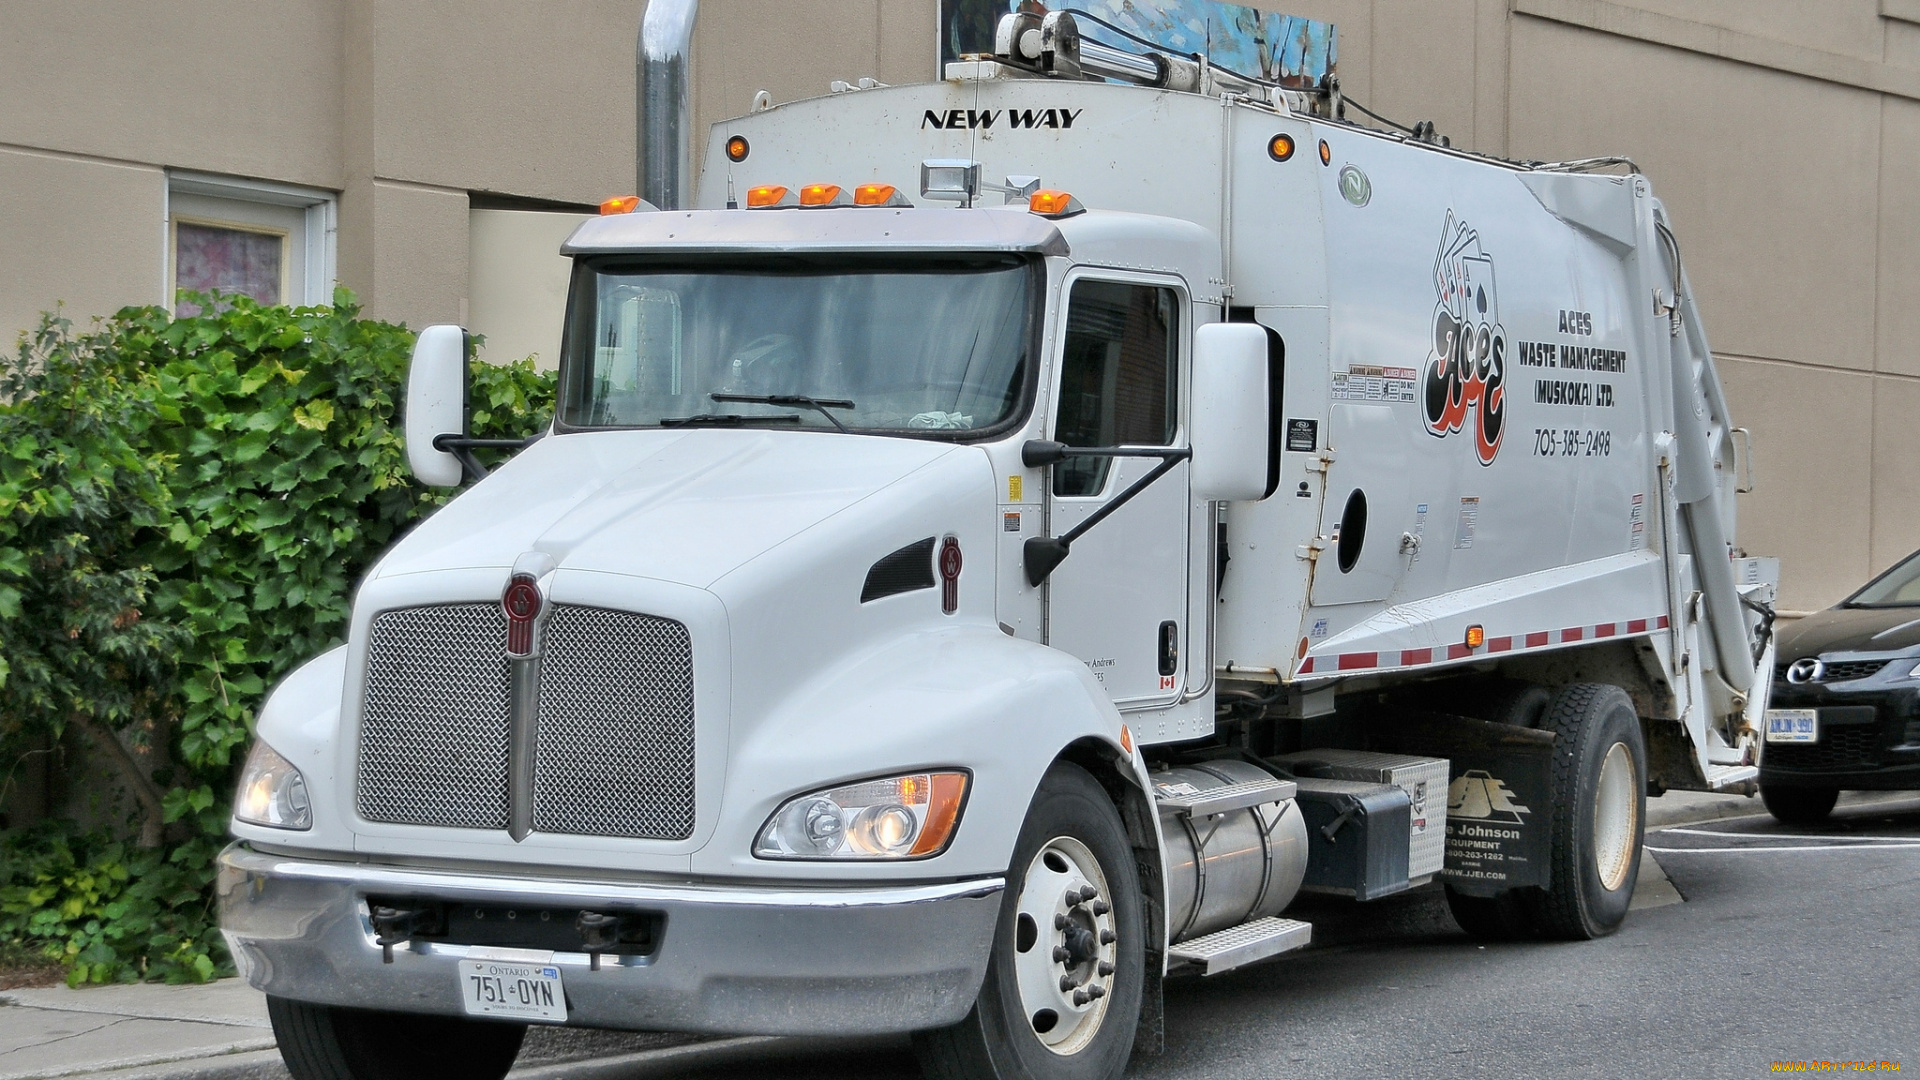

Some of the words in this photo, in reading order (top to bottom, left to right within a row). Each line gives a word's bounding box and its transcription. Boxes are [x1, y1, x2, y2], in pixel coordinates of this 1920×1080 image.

[921, 109, 1002, 130] NEW
[1008, 108, 1083, 129] WAY
[1558, 310, 1592, 336] ACES
[1518, 341, 1556, 368] WASTE
[1560, 345, 1627, 373] MANAGEMENT
[1400, 381, 1406, 389] DO
[1407, 382, 1415, 390] NOT
[1424, 310, 1505, 452] Aces
[1534, 380, 1592, 406] (MUSKOKA)
[1596, 384, 1614, 407] LTD.
[1533, 428, 1611, 456] 705-385-2498
[1092, 658, 1116, 668] Andrews
[1458, 824, 1520, 839] Johnson
[489, 965, 530, 976] ONTARIO
[470, 975, 507, 1004] 751
